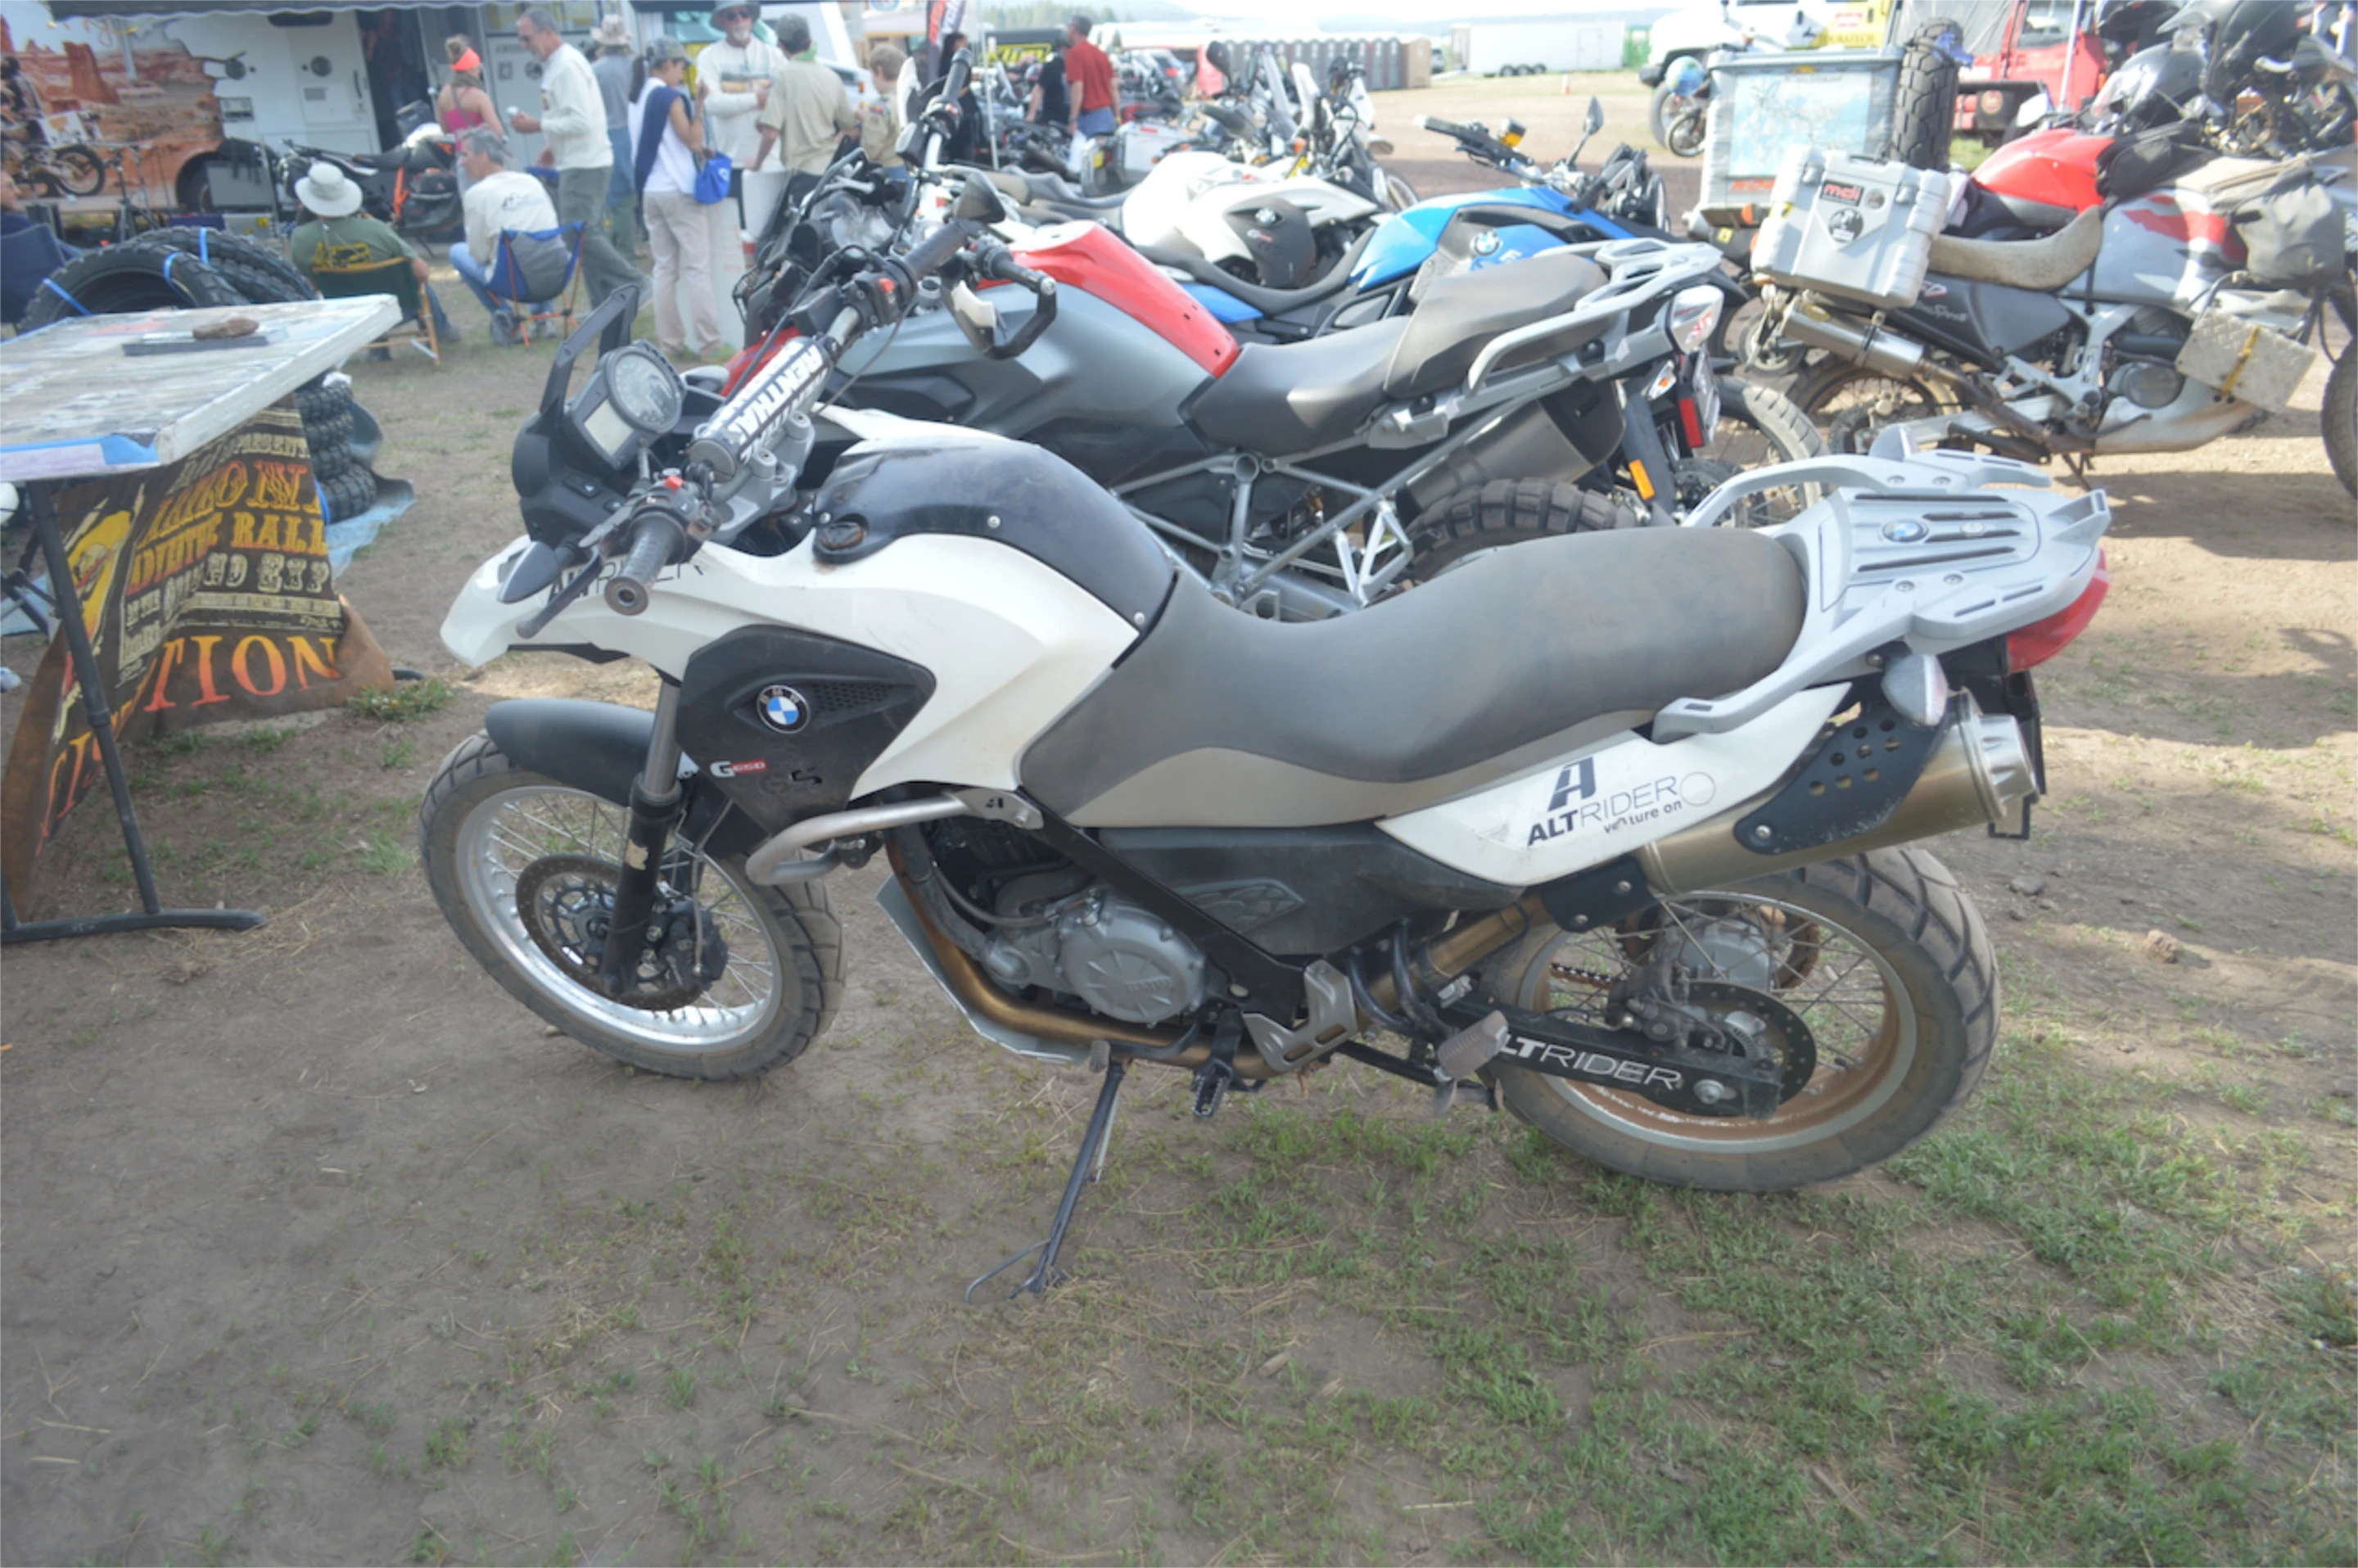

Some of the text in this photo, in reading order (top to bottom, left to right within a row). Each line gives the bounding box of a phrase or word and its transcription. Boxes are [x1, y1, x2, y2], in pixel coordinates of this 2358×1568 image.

[1526, 775, 1678, 847] ALTRIDER
[1663, 799, 1683, 814] on
[1500, 1032, 1683, 1091] LTRIDER
